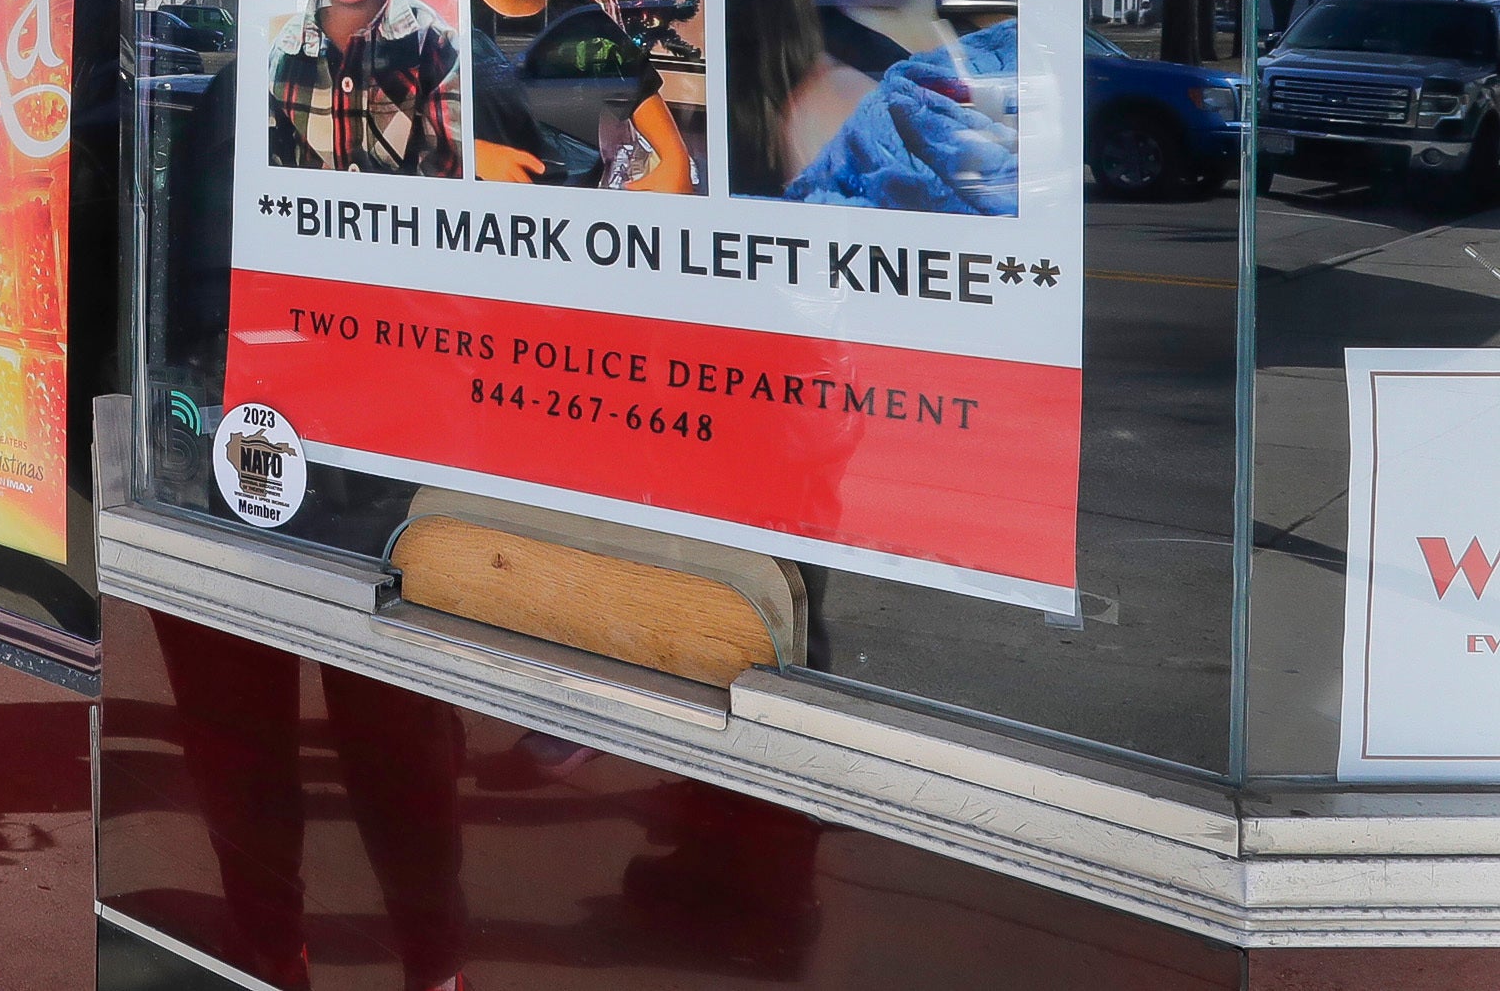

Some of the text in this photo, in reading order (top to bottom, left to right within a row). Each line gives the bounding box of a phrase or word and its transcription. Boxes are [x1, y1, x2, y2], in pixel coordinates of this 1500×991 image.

[436, 208, 573, 263] MARK
[585, 221, 661, 271] ON
[680, 229, 810, 285] LEFT
[289, 309, 979, 430] TWO RIVERS POLICE DEPARTMENT
[243, 407, 276, 429] 2023
[471, 379, 713, 442] 844-267-6648
[240, 446, 282, 479] NATO
[6, 478, 34, 494] IMAX
[238, 499, 281, 521] Member
